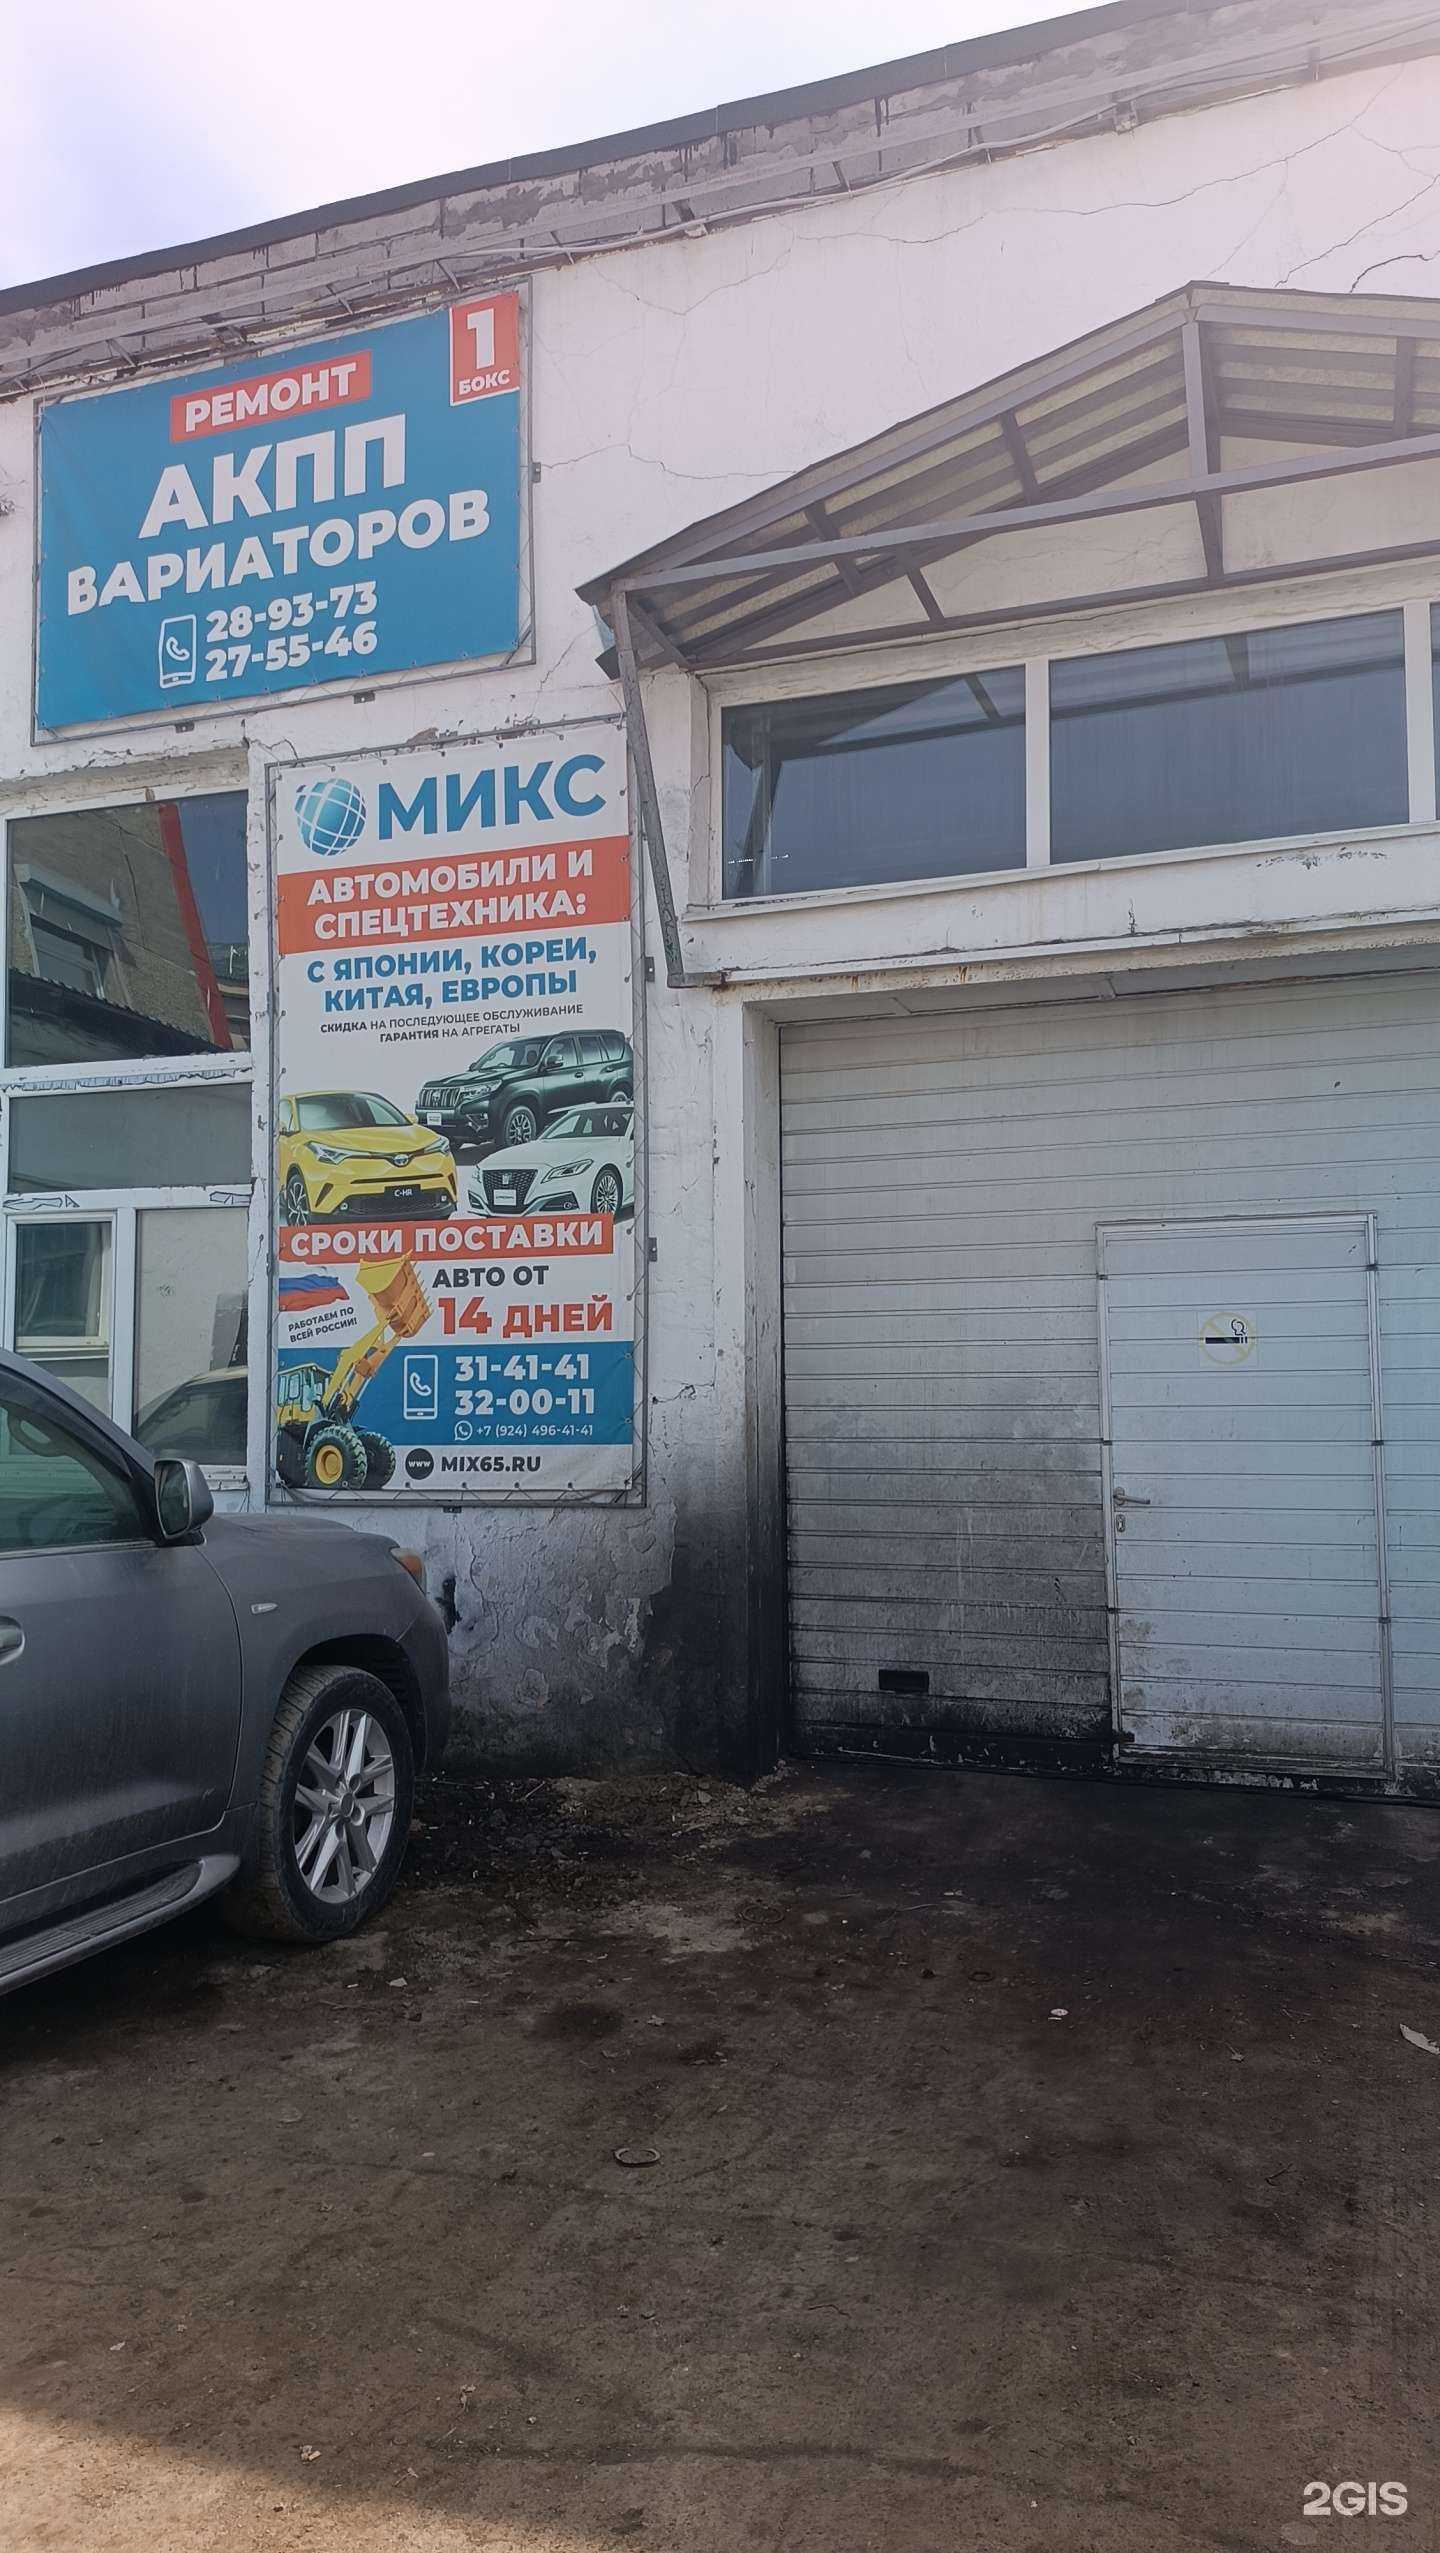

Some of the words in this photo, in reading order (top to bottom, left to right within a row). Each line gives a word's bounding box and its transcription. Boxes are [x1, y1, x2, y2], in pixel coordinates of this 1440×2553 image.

[466, 307, 496, 370] 1
[185, 361, 358, 433] РЕМОНТ
[458, 368, 511, 394] БОКС
[138, 413, 407, 539] АКПП
[66, 488, 491, 616] ВАРИАТОРОВ
[206, 580, 378, 642] 28-93-73
[205, 621, 378, 682] 27-55-46
[377, 753, 607, 841] МИКС
[307, 852, 557, 906] АВТОМОБИЛИ
[567, 849, 594, 879] И
[314, 889, 587, 940] СПЕЦТЕХНИКА:
[307, 960, 325, 983] С
[333, 948, 472, 981] ЯПОНИИ,
[481, 936, 597, 969] КОРЕИ,
[324, 982, 433, 1012] КИТАЯ,
[442, 969, 577, 1004] ЕВРОПЫ
[320, 1020, 368, 1034] СКИДКА
[370, 1018, 387, 1031] НА
[389, 1011, 480, 1030] ПОСЛЕДУЮЩЕЕ
[482, 1003, 584, 1022] ОБСЛУЖИВАНИЕ
[379, 1029, 440, 1043] ГАРАНТИЯ
[442, 1027, 459, 1039] НА
[461, 1022, 520, 1038] АГРЕГАТЫ
[290, 1228, 403, 1257] СРОКИ
[415, 1220, 603, 1254] ПОСТАВКИ
[432, 1266, 505, 1289] АВТО
[513, 1264, 549, 1286] ОТ
[287, 1310, 339, 1333] РАБОТАЕМ
[340, 1306, 355, 1317] ПО
[289, 1328, 314, 1343] ВСЕЙ
[315, 1317, 359, 1336] РОССИИ!
[437, 1296, 493, 1336] 14
[502, 1294, 614, 1339] ДНЕЙ
[454, 1353, 590, 1382] 31-41-41
[454, 1388, 596, 1417] 32-00-11
[476, 1424, 492, 1436] +7
[494, 1423, 528, 1438] (924)
[531, 1424, 594, 1437] 496-41-41
[440, 1455, 542, 1473] MIX65.RU
